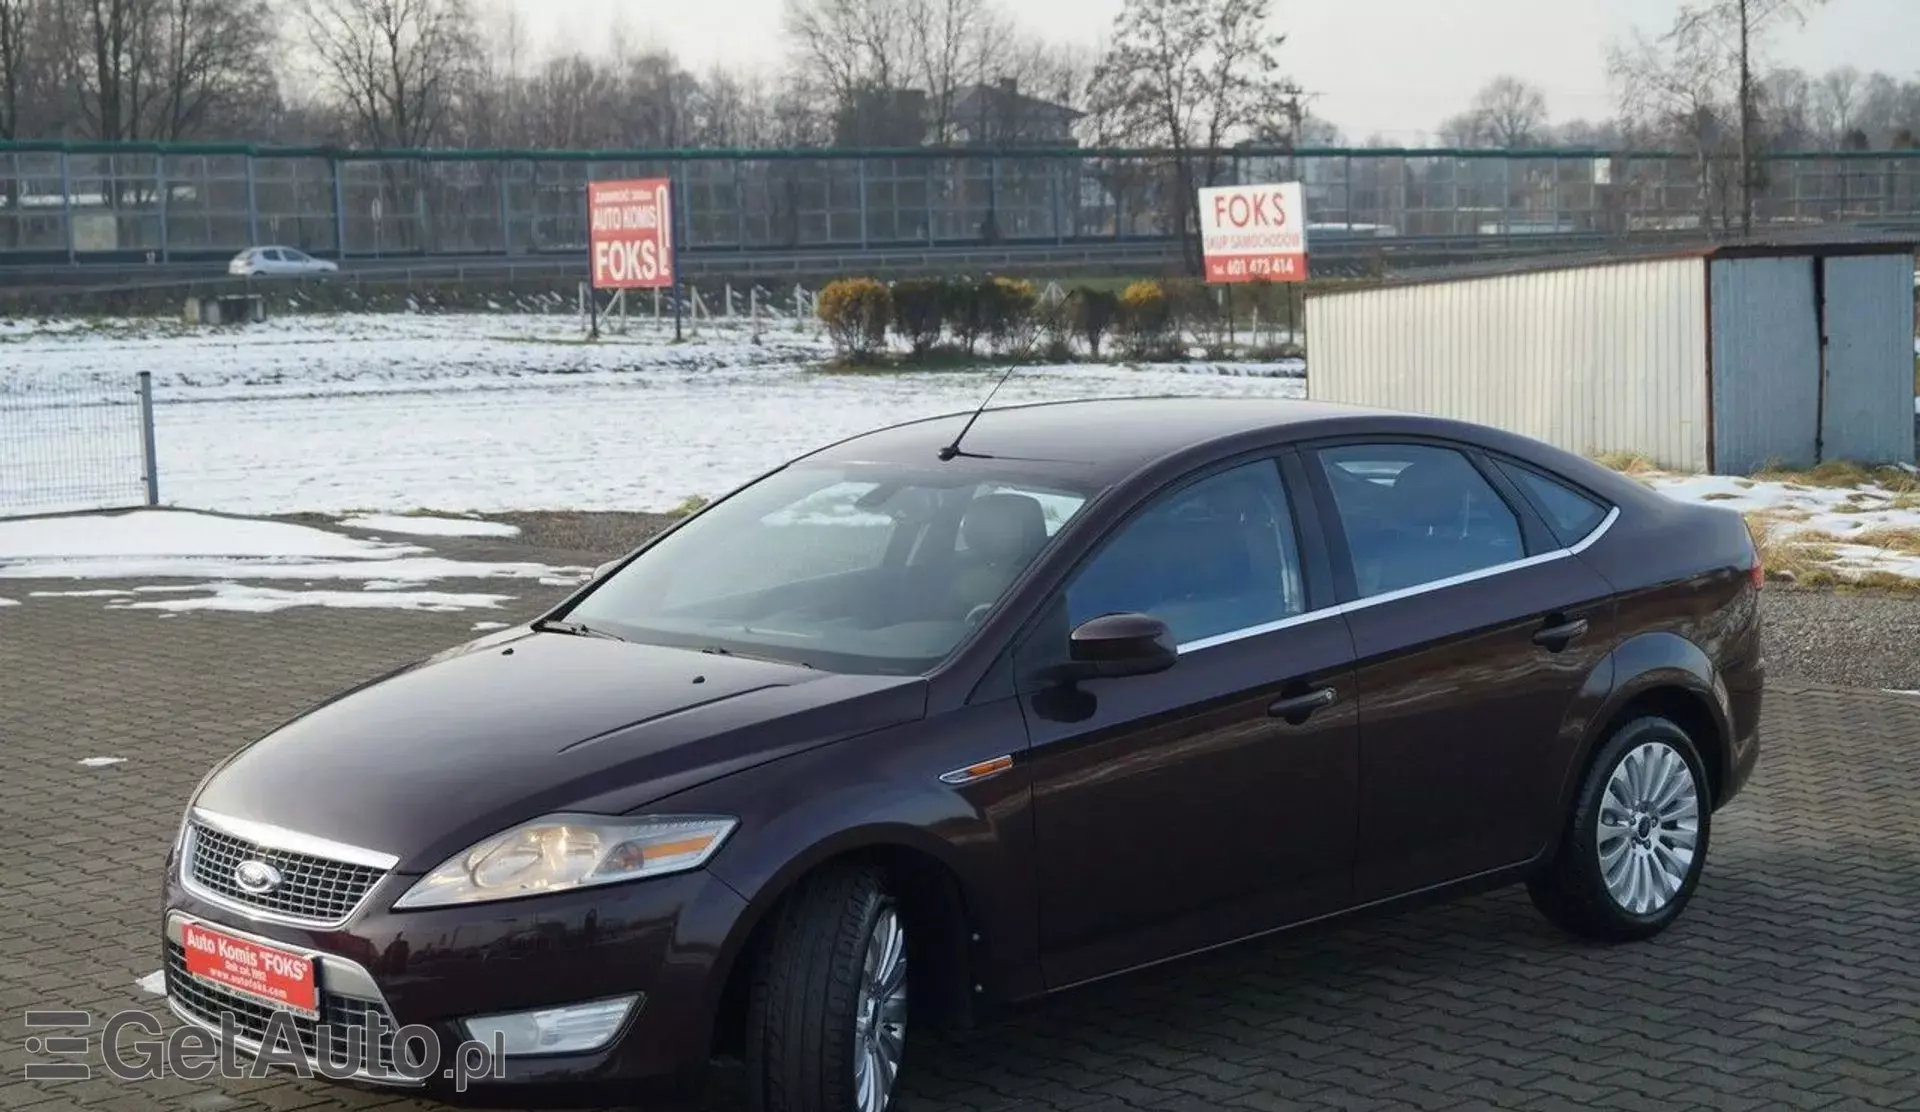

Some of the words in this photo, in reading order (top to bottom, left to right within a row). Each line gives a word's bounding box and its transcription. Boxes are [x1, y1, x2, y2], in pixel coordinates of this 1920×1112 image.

[592, 206, 622, 231] AUTO
[622, 205, 656, 229] KOMIS
[1214, 192, 1286, 228] FOKS
[595, 239, 657, 281] FOKS
[1227, 258, 1247, 275] 601
[1272, 256, 1295, 274] 414
[187, 928, 216, 954] Auto
[218, 937, 258, 967] Komis
[259, 950, 308, 981] "FOKS"
